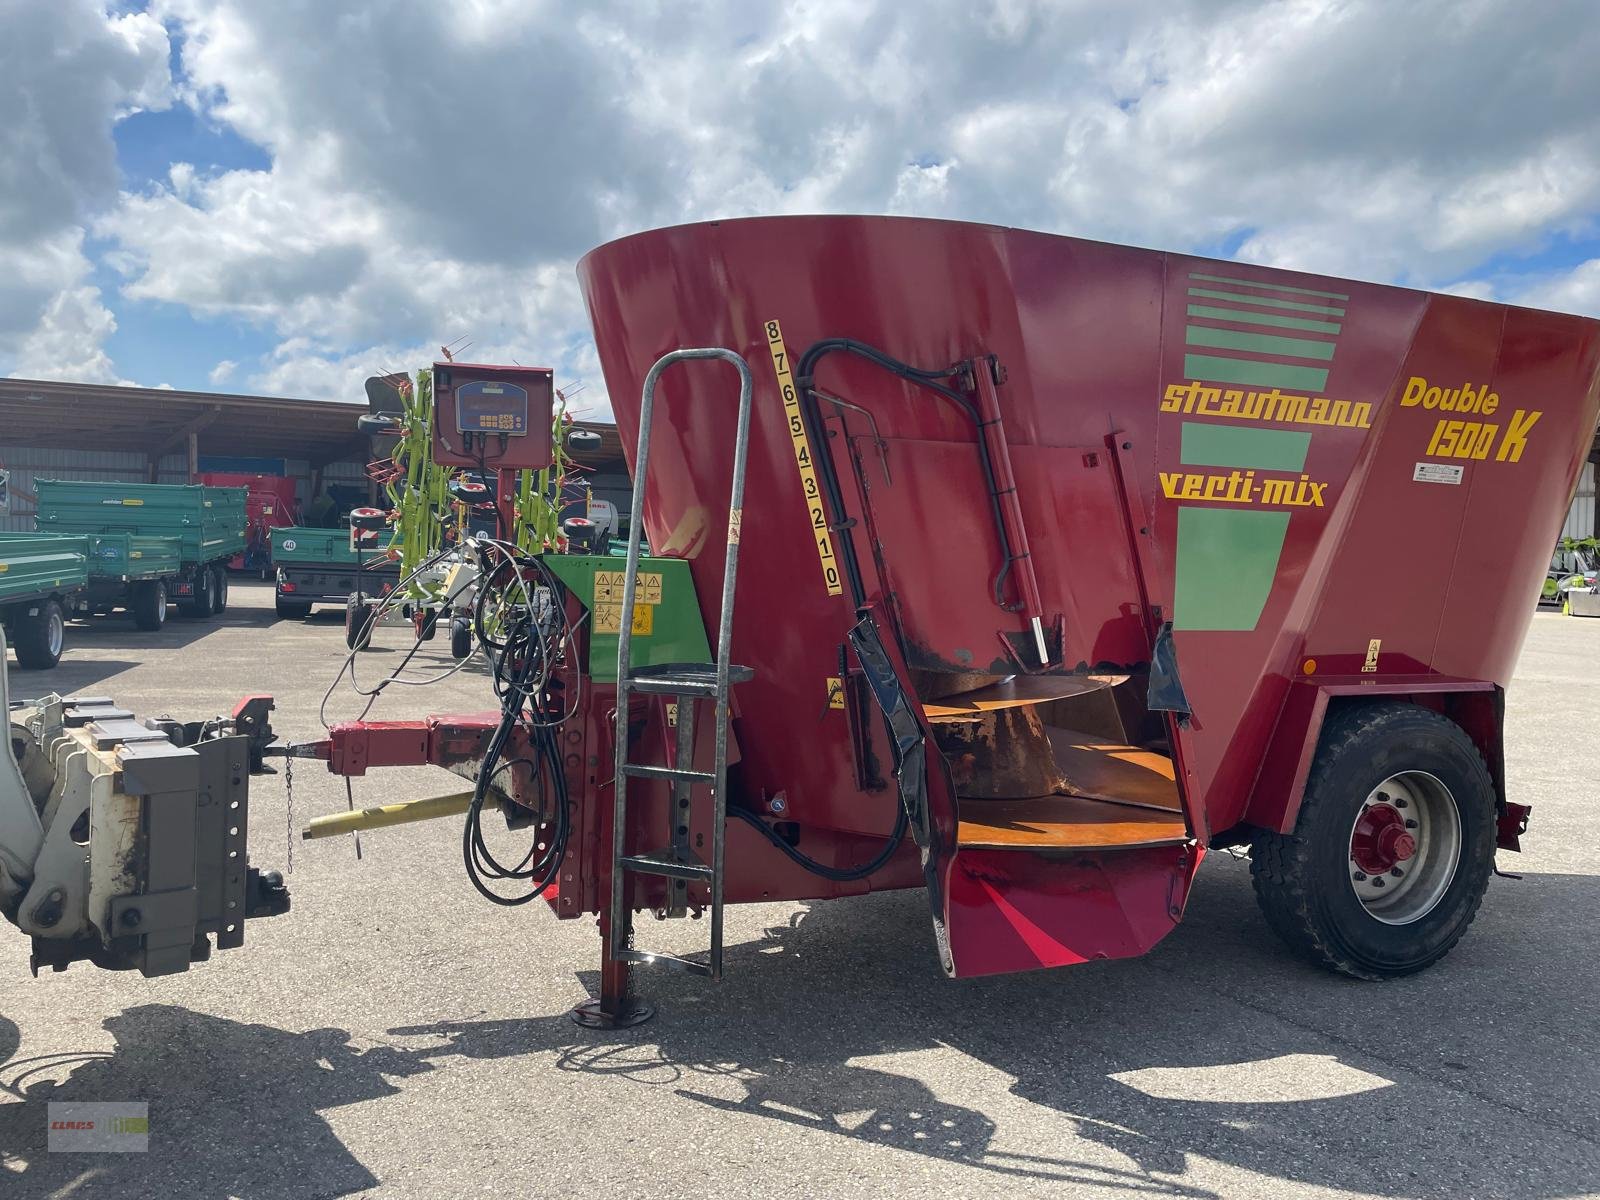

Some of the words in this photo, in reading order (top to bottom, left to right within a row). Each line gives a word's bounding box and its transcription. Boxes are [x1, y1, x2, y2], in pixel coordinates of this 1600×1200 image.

[767, 321, 779, 339] 8
[774, 353, 785, 370] 7
[783, 384, 794, 402] 6
[1400, 376, 1500, 415] Double
[1160, 381, 1373, 429] strautmann
[791, 415, 802, 433] 5
[1425, 419, 1500, 460] 1500
[1495, 409, 1544, 463] K
[798, 446, 809, 464] 4
[804, 477, 816, 495] 3
[1159, 471, 1329, 507] verti-mix
[812, 508, 824, 526] 2
[285, 541, 295, 549] 40
[819, 538, 829, 554] 1
[826, 567, 837, 584] 0
